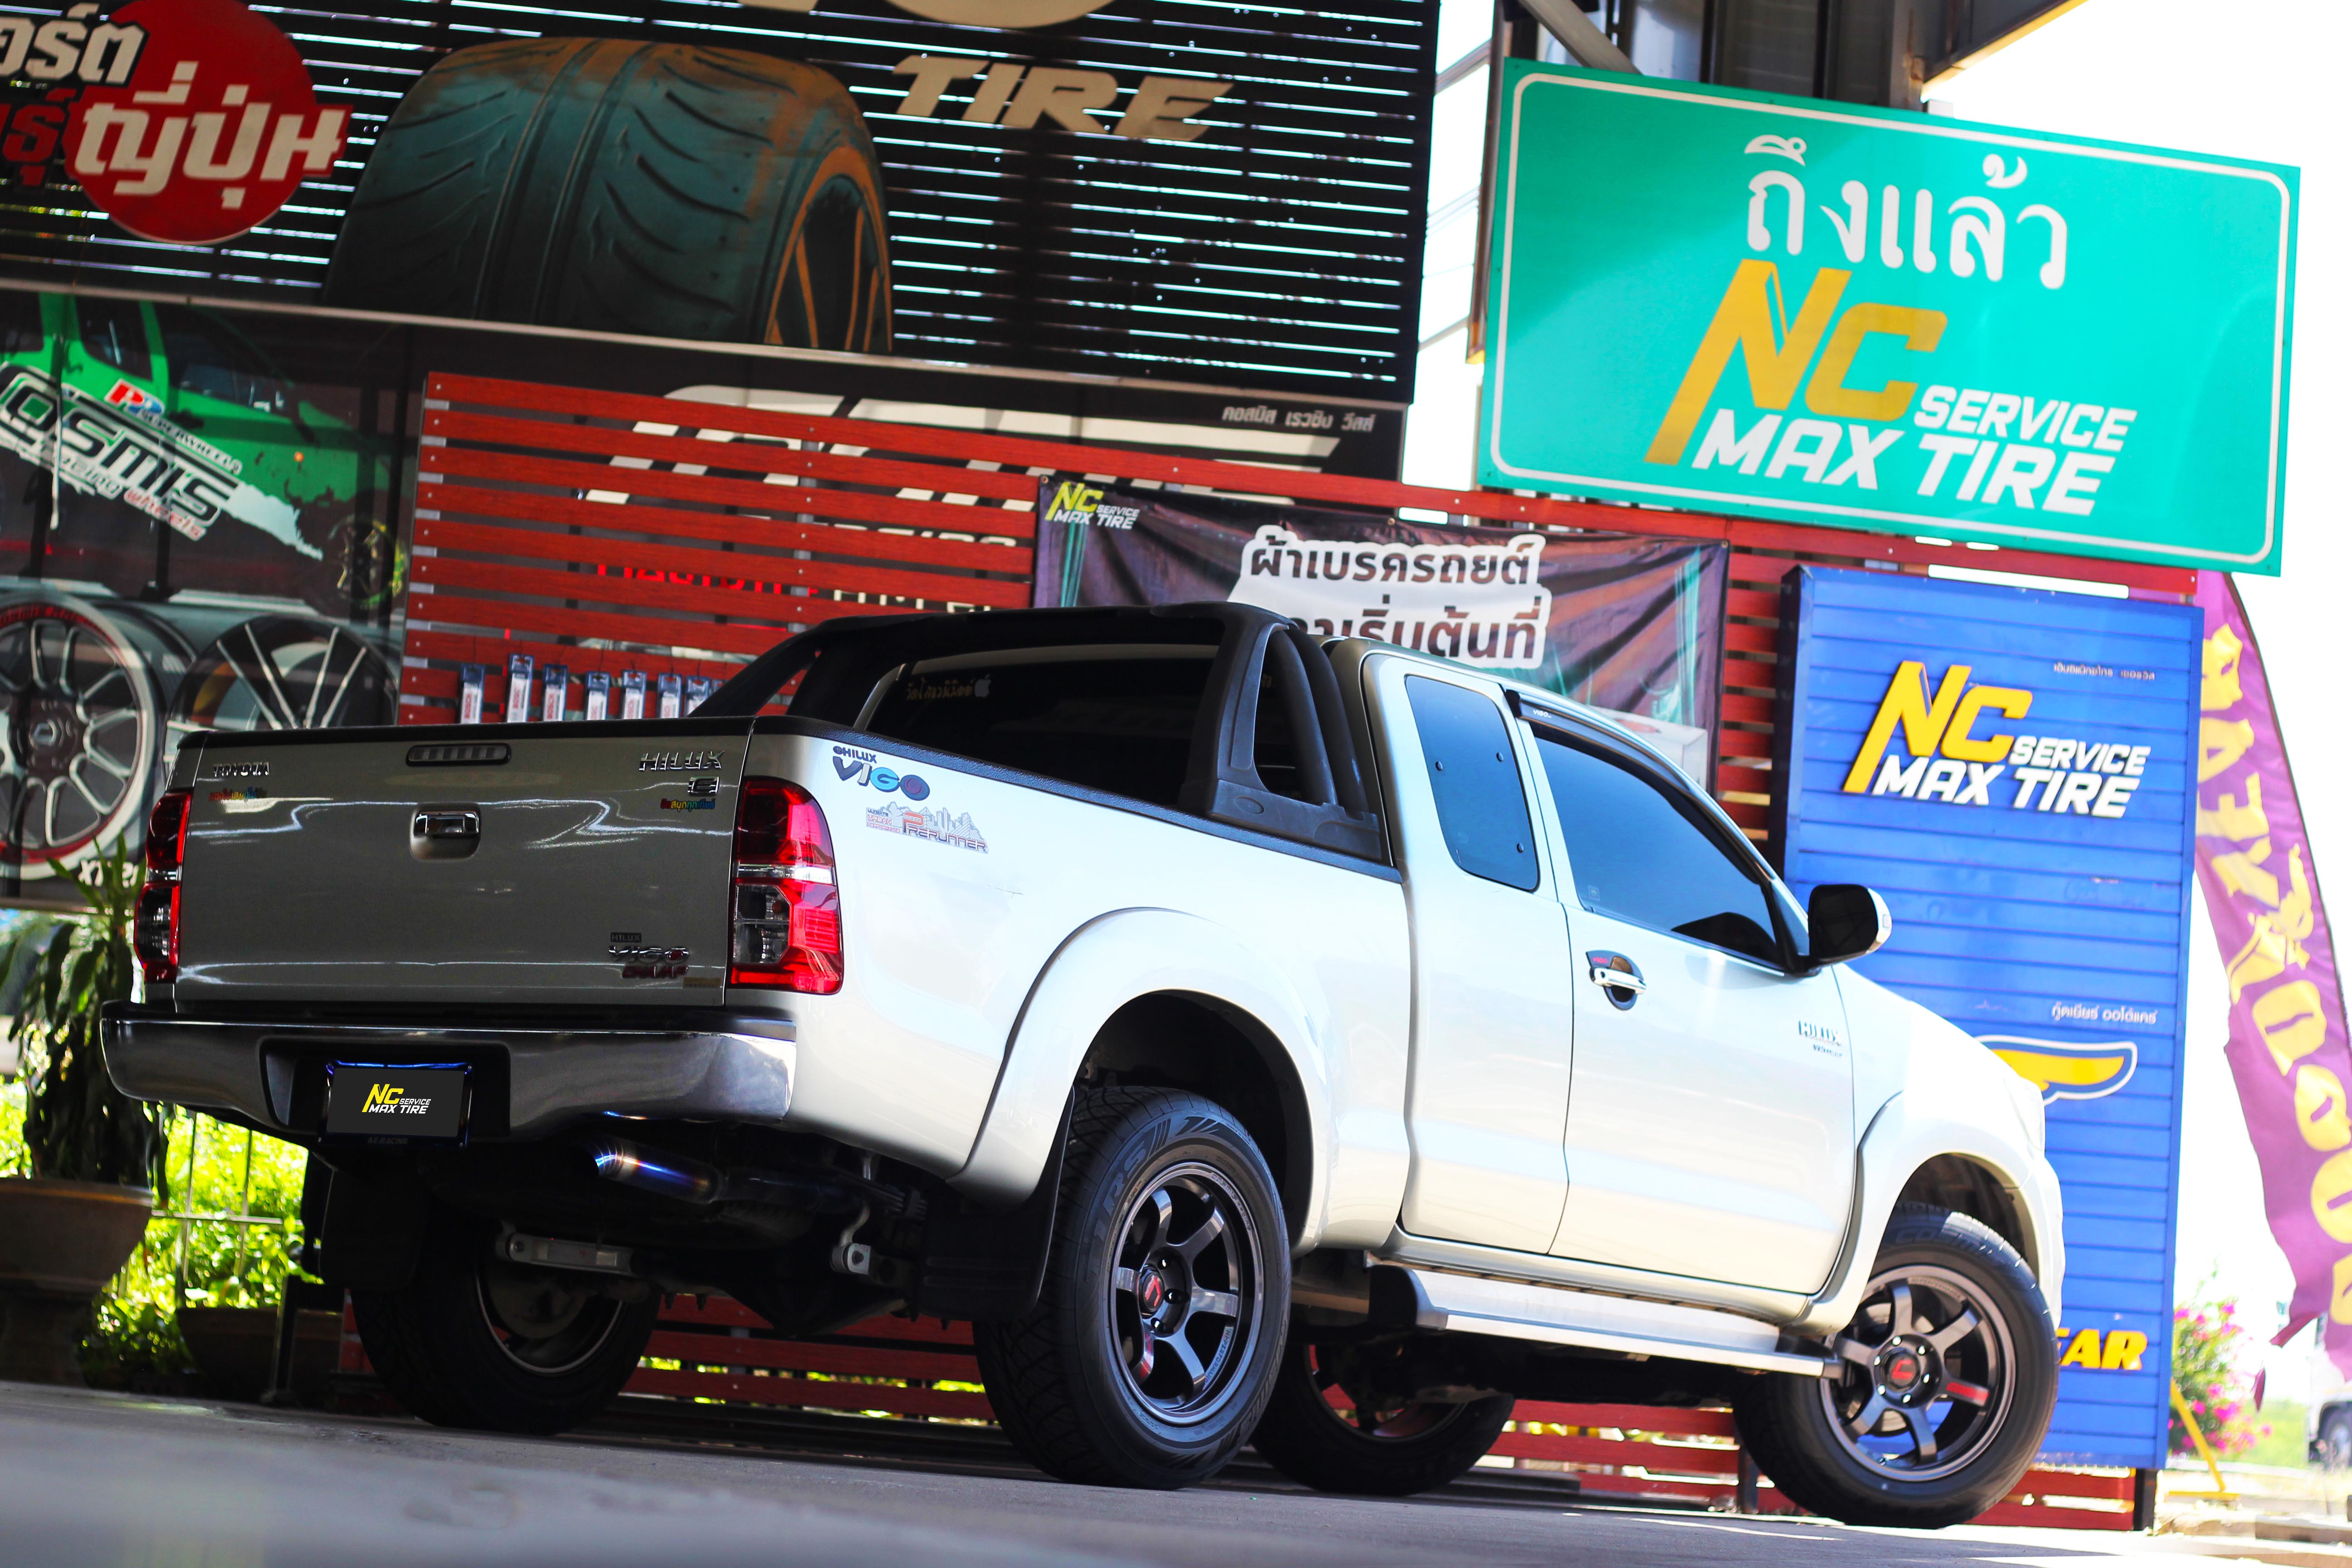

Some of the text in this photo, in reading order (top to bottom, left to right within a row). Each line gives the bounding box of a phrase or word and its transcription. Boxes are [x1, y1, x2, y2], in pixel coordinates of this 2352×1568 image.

[892, 54, 1235, 142] TIRE
[1743, 134, 2068, 289] ถึงแล้ว
[1643, 258, 2137, 466] NC SERVICE
[1691, 408, 2116, 516] MAX TIRE
[1045, 481, 1140, 521] NC SERVICE
[1054, 509, 1137, 530] MAX TIRE
[1843, 660, 2151, 794] NC SERVICE
[213, 762, 270, 777] TOYOTA
[639, 751, 725, 771] HILUX
[833, 756, 930, 801] VIGO
[1872, 754, 2140, 818] MAX TIRE
[867, 814, 892, 825] URBAN
[902, 810, 987, 852] PRERUNNER
[1798, 1019, 1842, 1046] HILUX
